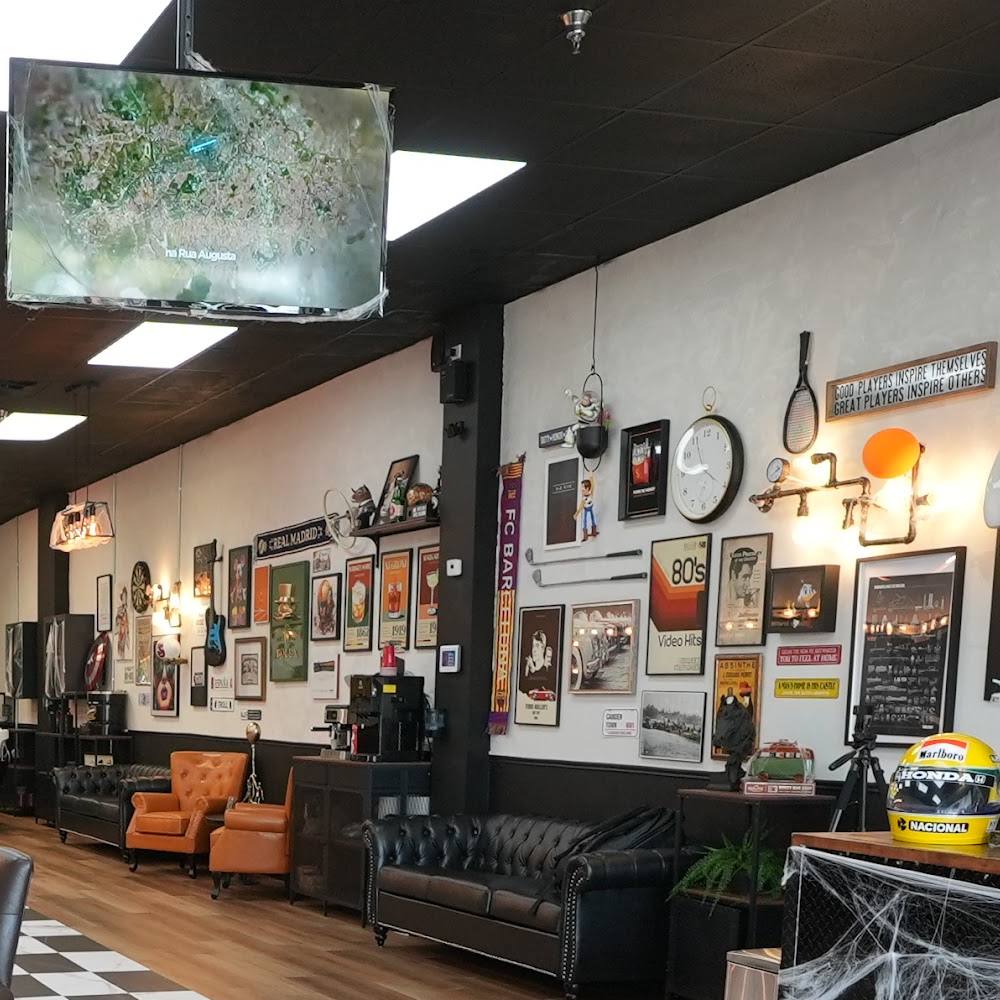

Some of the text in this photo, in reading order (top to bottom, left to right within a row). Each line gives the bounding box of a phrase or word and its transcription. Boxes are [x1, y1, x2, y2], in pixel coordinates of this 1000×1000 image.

[165, 248, 237, 262] na Rua Augusta
[834, 350, 987, 401] GOOD PLAYERS INSPIRE THEMSELVES
[834, 367, 986, 416] GREAT PLAYERS INSPIRE OTHERS
[504, 508, 517, 536] FC
[273, 526, 318, 549] REAL MADRID
[671, 557, 706, 585] 80's
[391, 625, 406, 637] 1919
[658, 634, 703, 647] Video Hits
[720, 661, 756, 669] ABSINTHE
[919, 748, 964, 761] Marlboro
[900, 770, 975, 783] HONDA
[910, 821, 969, 833] NACIONAL
